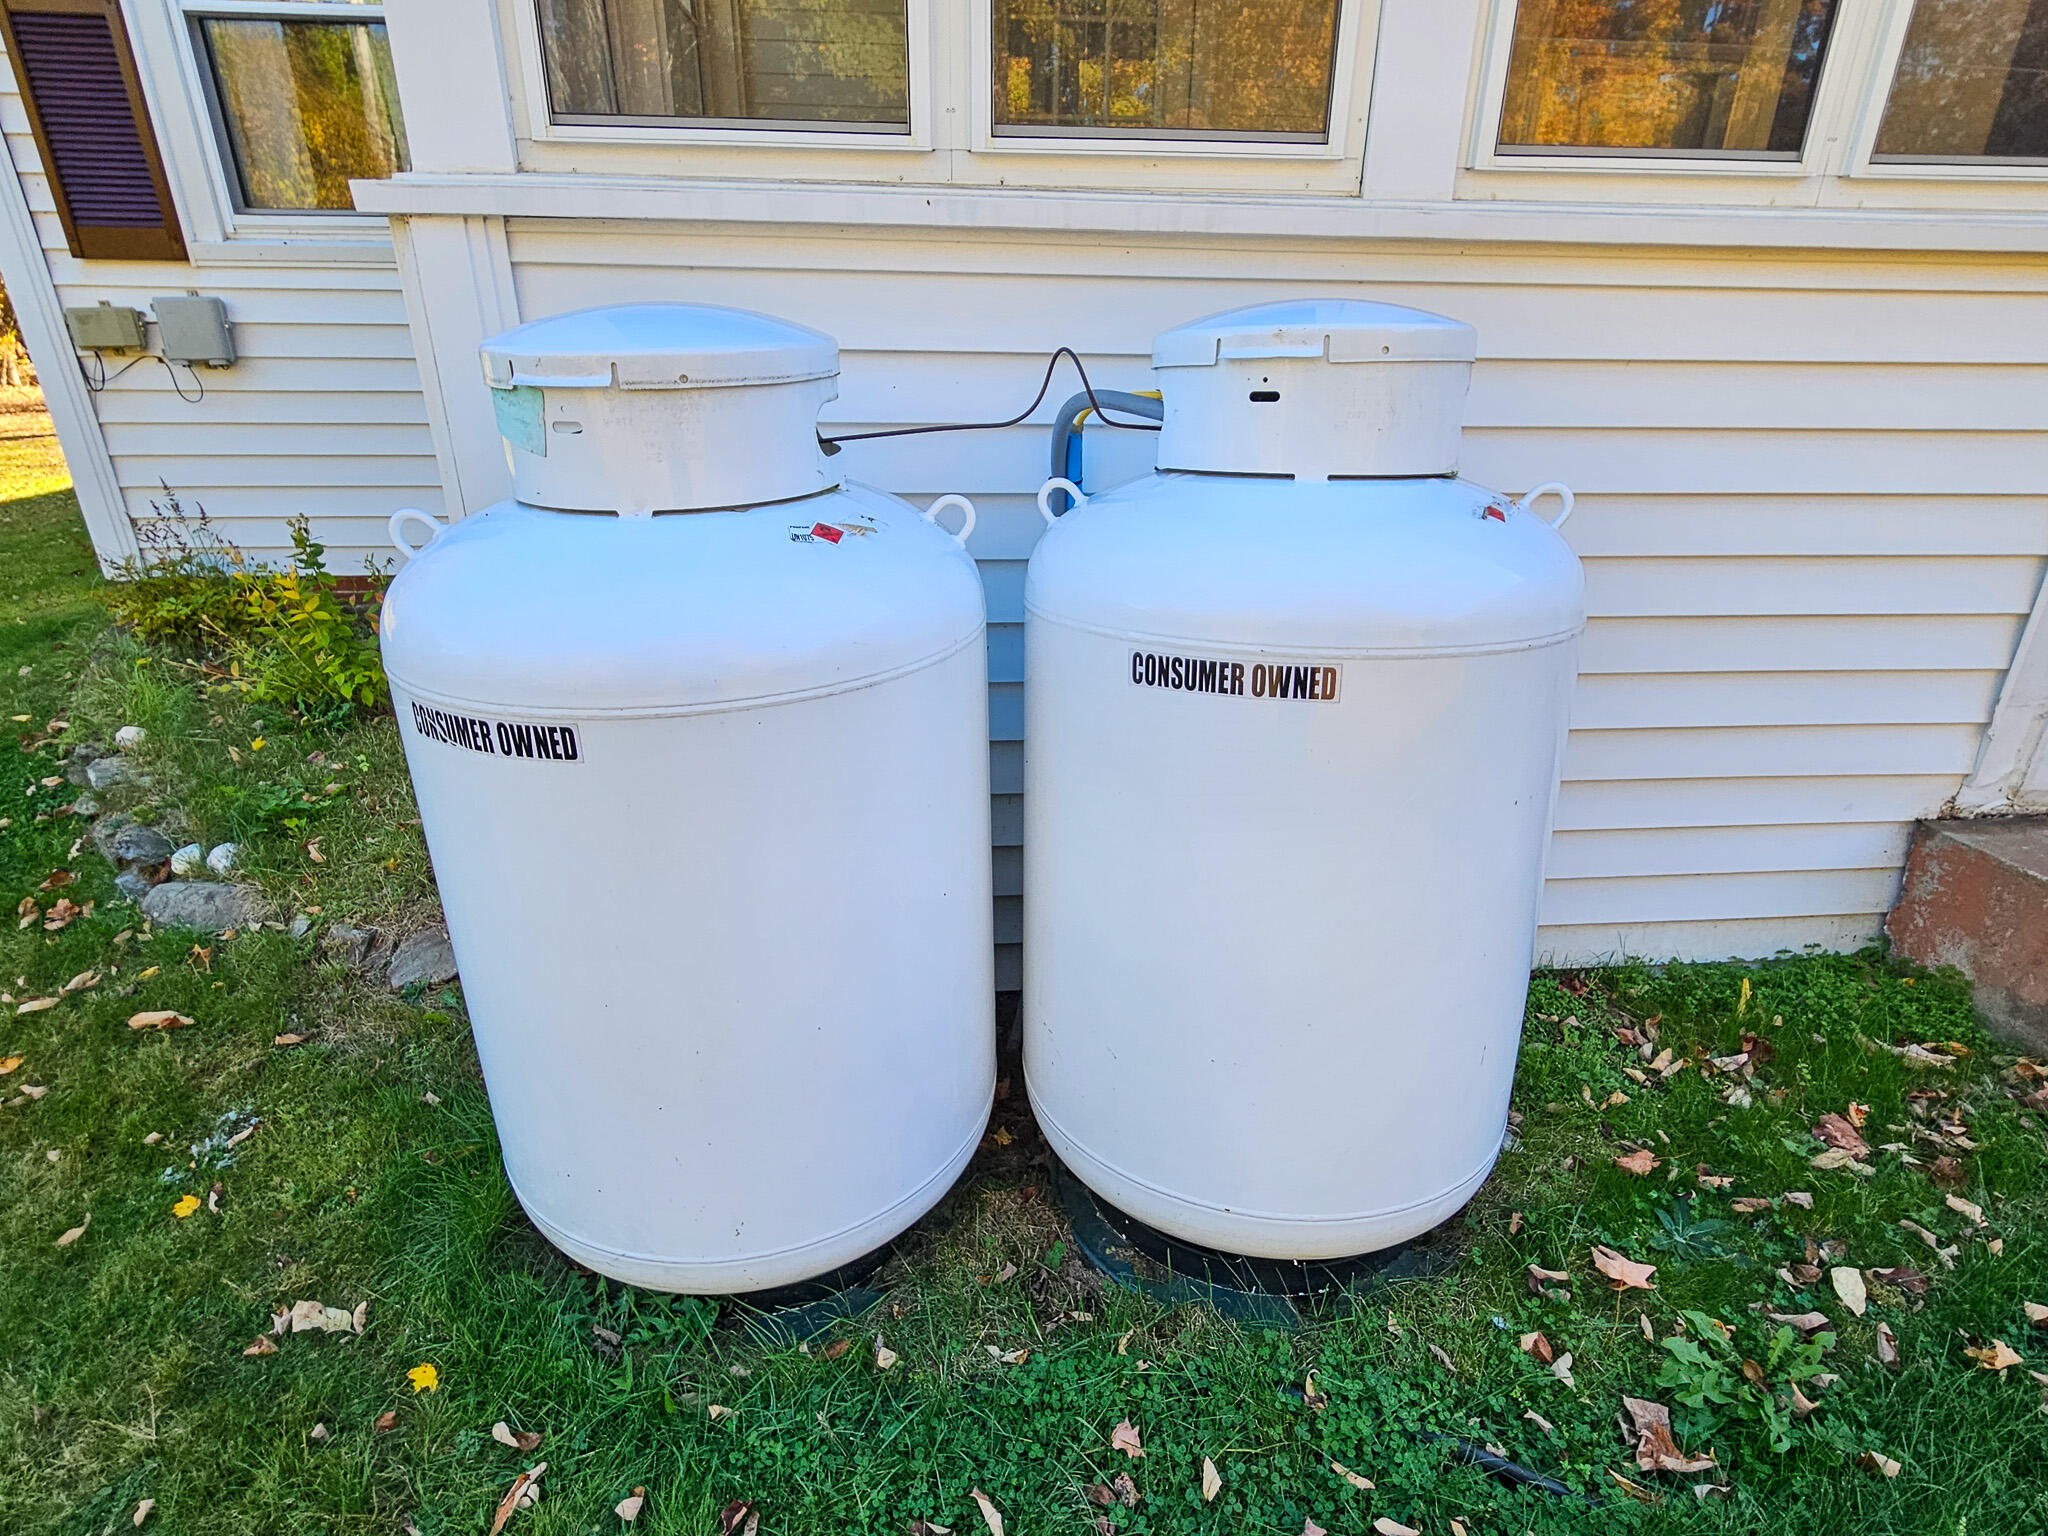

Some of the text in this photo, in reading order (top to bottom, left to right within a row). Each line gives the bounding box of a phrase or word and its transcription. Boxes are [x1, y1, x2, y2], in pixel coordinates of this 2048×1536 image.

[1132, 652, 1337, 700] CONSUMER OWNED
[411, 701, 578, 761] CONSUMER OWNED
